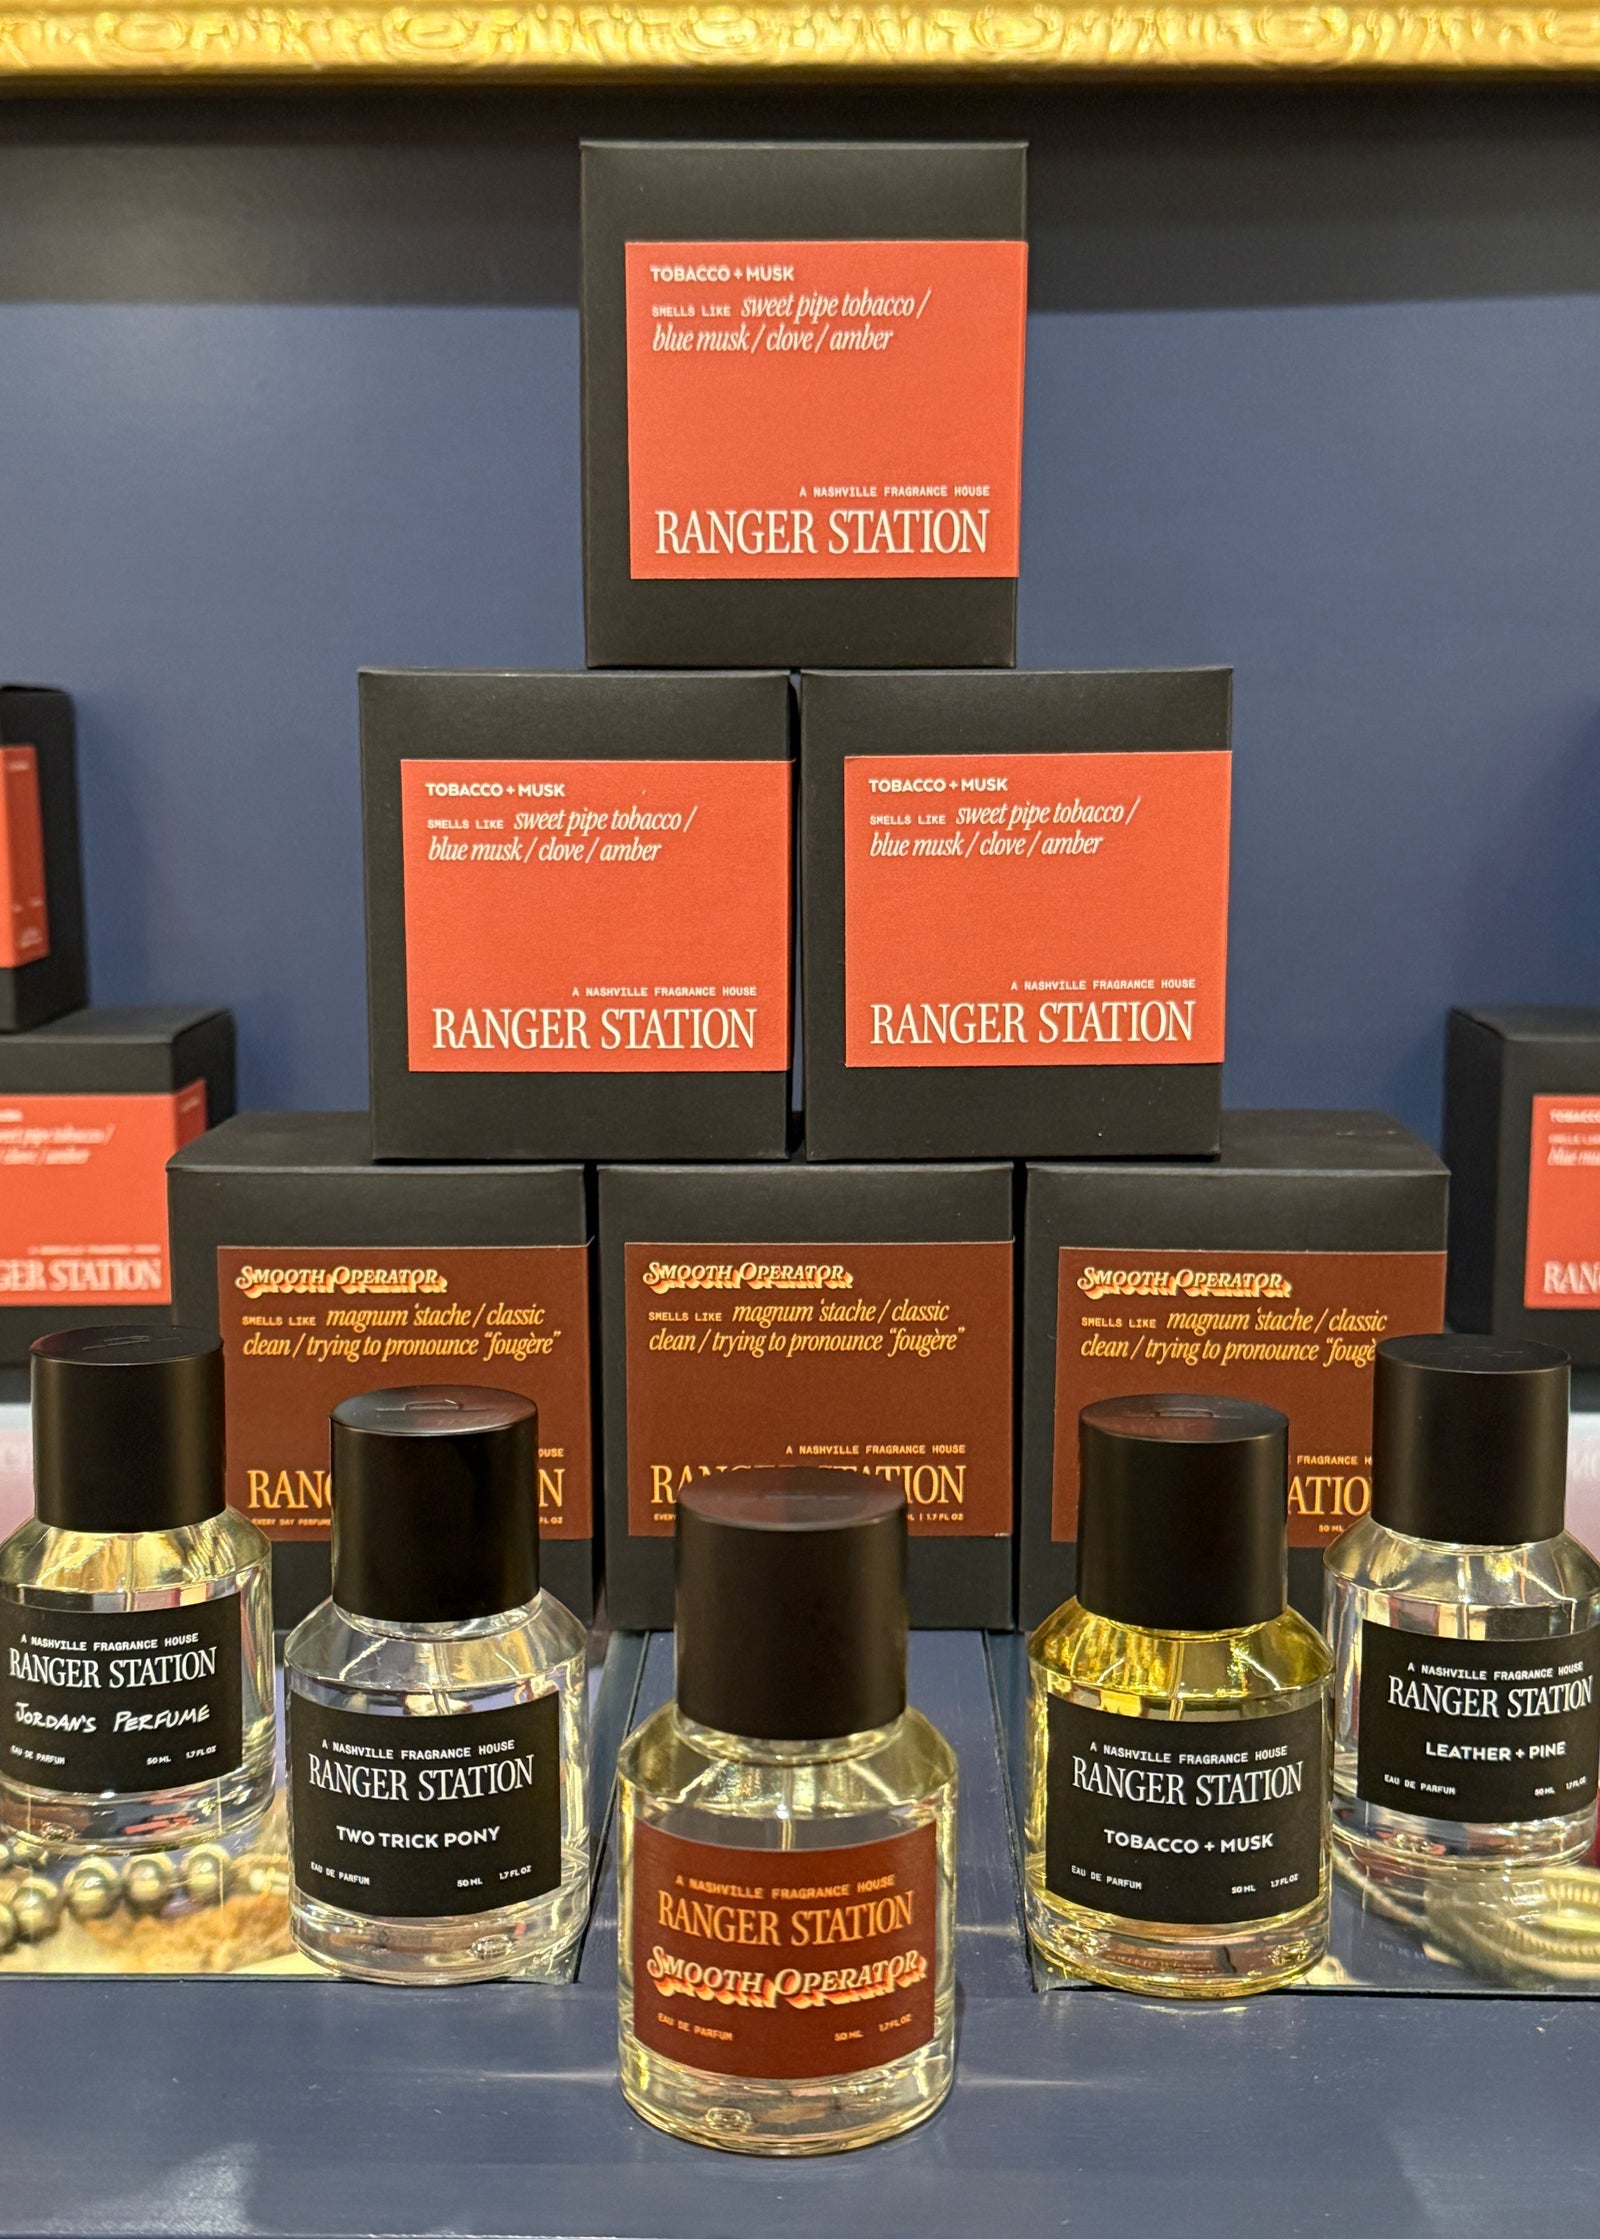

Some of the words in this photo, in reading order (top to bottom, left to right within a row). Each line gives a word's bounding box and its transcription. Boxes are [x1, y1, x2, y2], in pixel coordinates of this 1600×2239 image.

[651, 266, 730, 282] TOBACCO
[734, 270, 743, 279] +
[746, 267, 794, 281] MUSK
[652, 306, 695, 317] SMELLS
[702, 305, 731, 317] LIKE
[741, 292, 794, 317] sweet
[796, 291, 838, 324] pipe
[842, 289, 915, 317] tobacco
[653, 323, 694, 352] blue
[697, 323, 750, 351] musk
[767, 324, 813, 350] clove
[830, 323, 893, 351] amber
[800, 487, 807, 497] A
[814, 486, 877, 497] NASHVILLE
[884, 486, 947, 497] FRAGRANCE
[955, 485, 990, 496] HOUSE
[655, 510, 818, 554] RANGER
[829, 508, 989, 553] STATION
[425, 784, 503, 797] TOBACCO
[506, 787, 515, 795] +
[518, 783, 565, 797] MUSK
[869, 779, 945, 792] TOBACCO
[949, 781, 958, 790] +
[961, 778, 1008, 791] MUSK
[427, 819, 469, 829] SMELLS
[476, 819, 504, 829] LIKE
[514, 811, 564, 830] sweet
[566, 808, 607, 837] pipe
[611, 806, 681, 830] tobacco
[870, 815, 911, 825] SMELLS
[918, 815, 946, 824] LIKE
[956, 805, 1007, 824] sweet
[1008, 801, 1050, 830] pipe
[1053, 798, 1124, 823] tobacco
[428, 836, 467, 861] blue
[471, 837, 522, 861] musk
[539, 837, 584, 861] clove
[600, 838, 661, 862] amber
[870, 832, 909, 856] blue
[913, 831, 963, 856] musk
[980, 831, 1026, 855] clove
[1041, 830, 1104, 855] amber
[572, 988, 579, 996] A
[586, 987, 647, 996] NASHVILLE
[655, 987, 716, 996] FRAGRANCE
[723, 987, 757, 996] HOUSE
[1011, 981, 1017, 990] A
[1024, 980, 1086, 990] NASHVILLE
[1093, 980, 1154, 990] FRAGRANCE
[1161, 979, 1195, 989] HOUSE
[433, 1008, 590, 1049] RANGER
[600, 1008, 757, 1049] STATION
[870, 1004, 1028, 1044] RANGER
[1039, 1001, 1195, 1042] STATION
[235, 1266, 336, 1298] SMOOTH
[333, 1266, 447, 1294] OPERATOR
[643, 1262, 740, 1294] SMOOTH
[739, 1262, 853, 1290] OPERATOR
[1077, 1267, 1177, 1299] SMOOTH
[1176, 1269, 1292, 1298] OPERATOR
[242, 1316, 283, 1326] SMELLS
[289, 1316, 316, 1326] LIKE
[326, 1306, 407, 1333] magnum
[486, 1303, 545, 1326] classic
[648, 1312, 688, 1321] SMELLS
[695, 1312, 722, 1322] LIKE
[732, 1303, 812, 1328] magnum
[891, 1299, 949, 1321] classic
[1082, 1318, 1122, 1328] SMELLS
[1129, 1319, 1156, 1328] LIKE
[1167, 1311, 1249, 1336] magnum
[1328, 1308, 1388, 1331] classic
[243, 1332, 290, 1356] clean
[306, 1334, 360, 1362] trying
[362, 1335, 381, 1356] to
[382, 1336, 478, 1362] pronounce
[649, 1328, 696, 1351] clean
[712, 1330, 764, 1358] trying
[768, 1332, 786, 1351] to
[787, 1333, 882, 1358] pronounce
[1081, 1334, 1128, 1357] clean
[1145, 1338, 1200, 1366] trying
[1202, 1342, 1221, 1360] to
[1222, 1342, 1318, 1365] pronounce
[1323, 1338, 1376, 1368] “fougè
[786, 1446, 792, 1454] A
[800, 1445, 859, 1454] NASHVILLE
[866, 1445, 925, 1454] FRAGRANCE
[932, 1445, 965, 1453] HOUSE
[1297, 1456, 1358, 1465] FRAGRANCE
[1288, 1476, 1371, 1516] ATIO
[21, 1634, 27, 1643] A
[32, 1637, 86, 1650] NASHVILLE
[94, 1639, 158, 1651] FRAGRANCE
[165, 1633, 199, 1647] HOUSE
[9, 1648, 101, 1688] RANGER
[109, 1647, 217, 1688] STATION
[1408, 1663, 1414, 1671] A
[1422, 1665, 1486, 1680] NASHVILLE
[1494, 1668, 1553, 1681] FRAGRANCE
[1559, 1662, 1583, 1676] HOUSE
[1388, 1676, 1499, 1718] RANGER
[1507, 1675, 1593, 1718] STATION
[113, 1704, 210, 1732] PERFUME
[322, 1740, 327, 1749] A
[333, 1742, 393, 1759] NASHVILLE
[402, 1748, 471, 1760] FRAGRANCE
[479, 1740, 515, 1755] HOUSE
[1090, 1742, 1096, 1751] A
[1104, 1744, 1171, 1763] NASHVILLE
[1179, 1752, 1248, 1764] FRAGRANCE
[1255, 1746, 1287, 1761] HOUSE
[1426, 1742, 1511, 1761] LEATHER
[1516, 1750, 1525, 1758] +
[1529, 1741, 1566, 1759] PINE
[309, 1754, 409, 1801] RANGER
[419, 1755, 534, 1801] STATION
[1073, 1756, 1187, 1805] RANGER
[1196, 1761, 1303, 1806] STATION
[337, 1826, 374, 1846] TWO
[379, 1833, 438, 1848] TRICK
[445, 1826, 499, 1847] PONY
[1104, 1829, 1198, 1854] TOBACCO
[1204, 1842, 1215, 1851] +
[1221, 1833, 1273, 1853] MUSK
[311, 1862, 322, 1873] EAU
[326, 1868, 335, 1877] DE
[339, 1872, 370, 1885] PARFUM
[676, 1875, 683, 1885] A
[690, 1878, 763, 1899] NASHVILLE
[772, 1885, 848, 1899] FRAGRANCE
[857, 1874, 895, 1893] HOUSE
[1072, 1866, 1085, 1876] EAU
[1091, 1872, 1101, 1882] DE
[1107, 1876, 1142, 1889] PARFUM
[658, 1890, 781, 1946] RANGER
[791, 1890, 914, 1946] STATION
[647, 1946, 777, 2008] SMOOTH
[775, 1950, 928, 2009] OPERATOR
